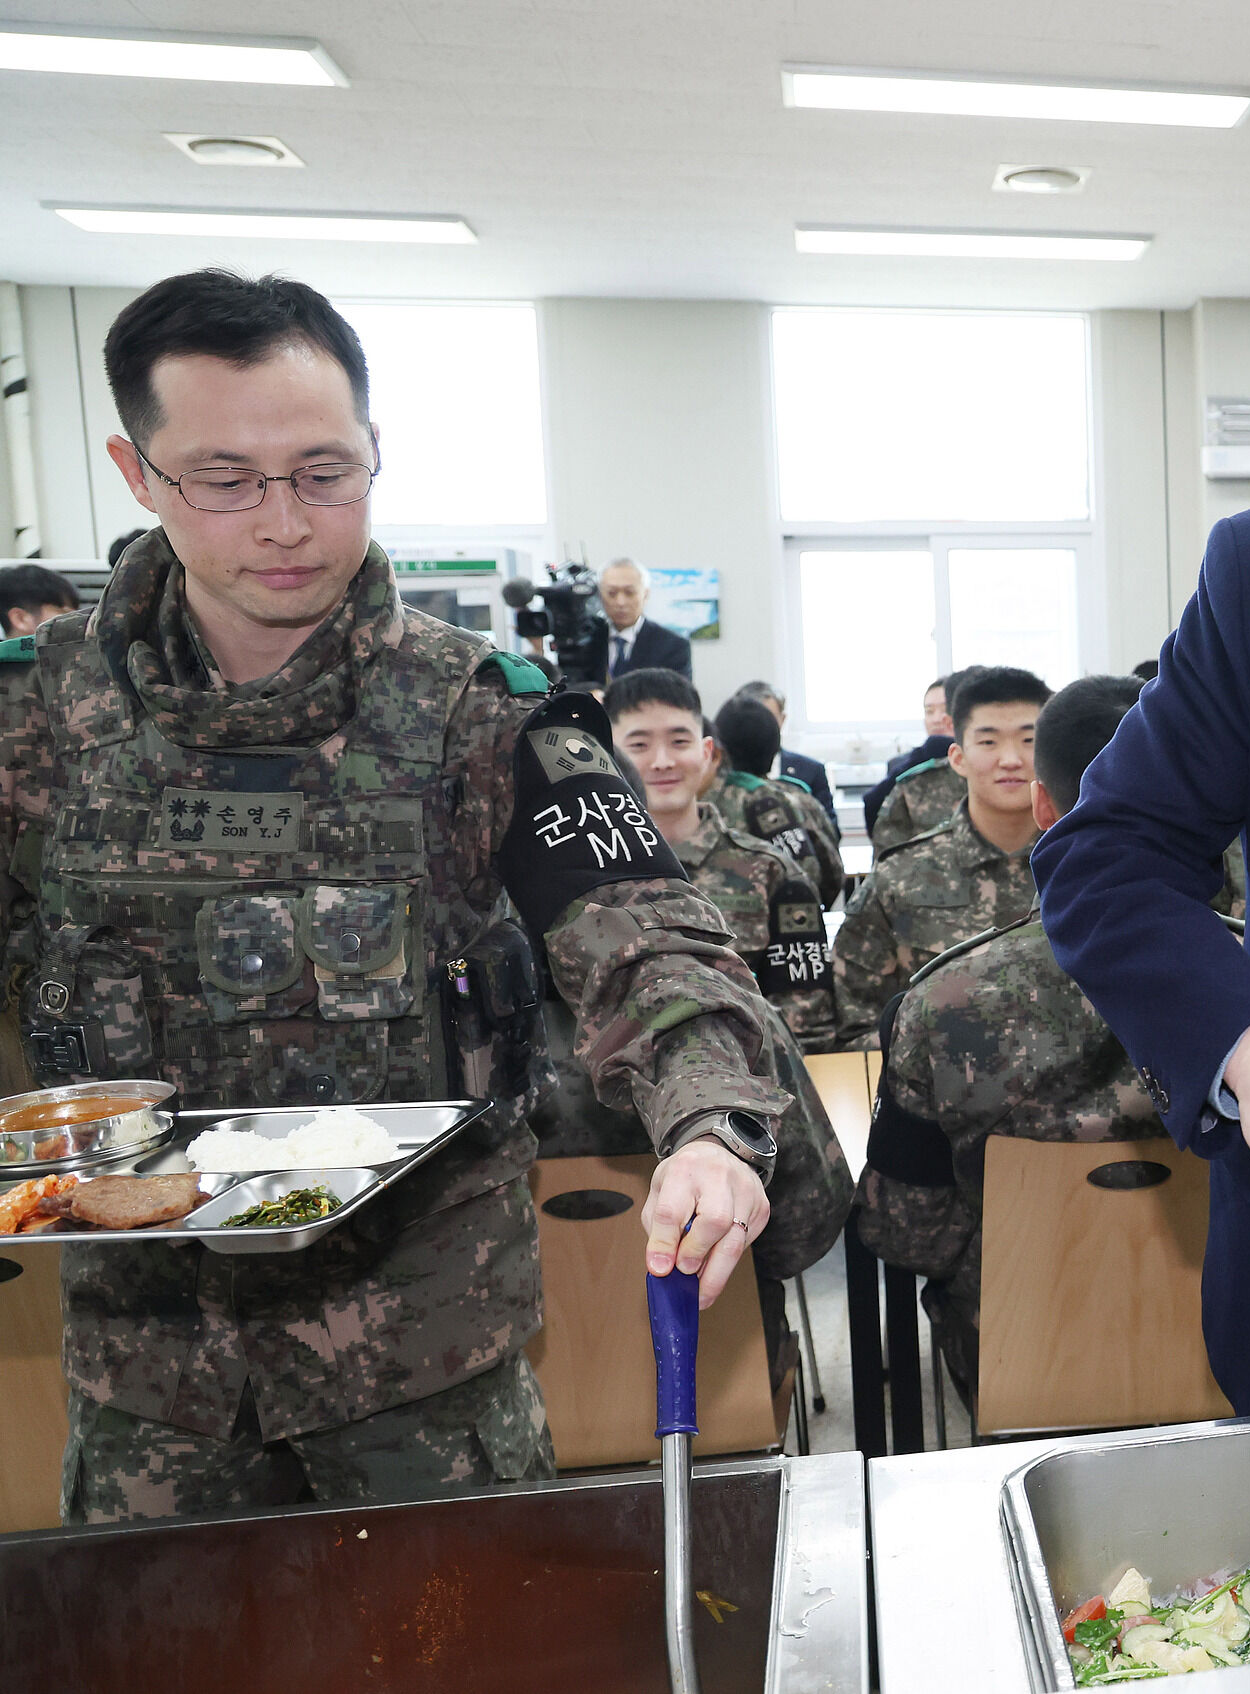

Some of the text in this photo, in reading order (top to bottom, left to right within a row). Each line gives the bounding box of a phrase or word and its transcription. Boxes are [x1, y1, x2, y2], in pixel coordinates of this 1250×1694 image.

[221, 826, 282, 838] SON Y.J
[533, 791, 657, 848] 군사경
[586, 826, 658, 869] MP
[788, 961, 825, 982] MP
